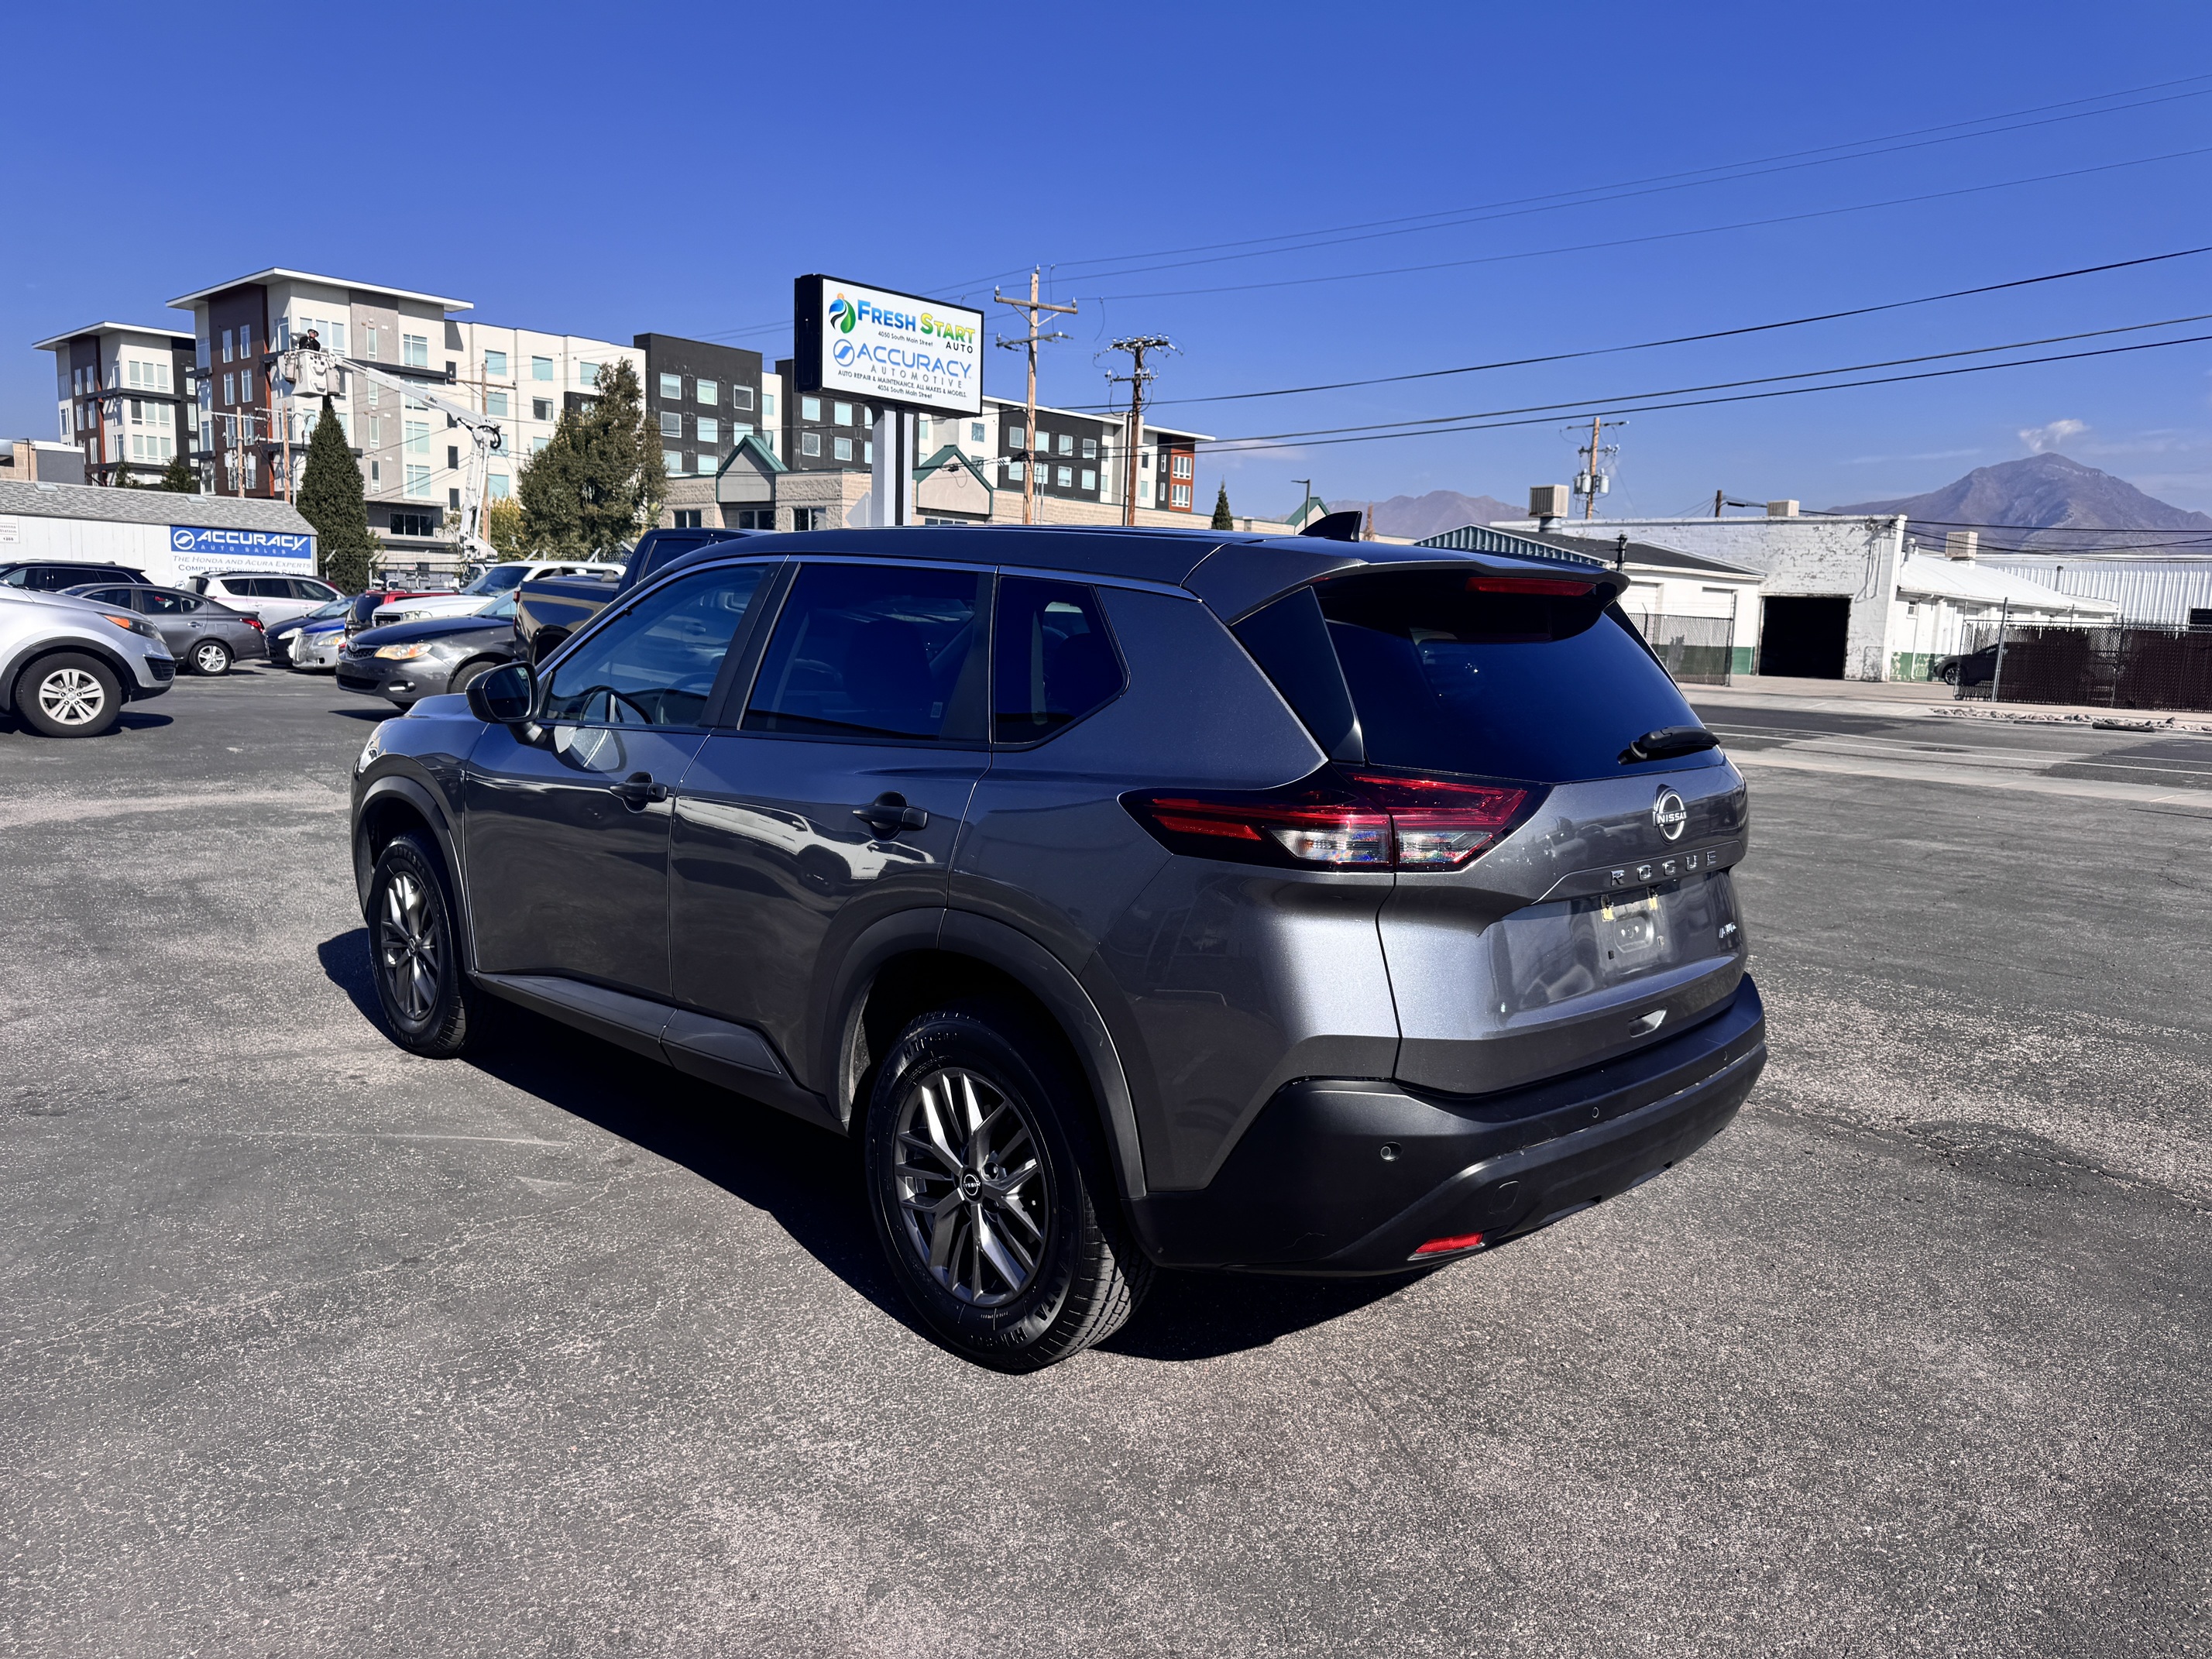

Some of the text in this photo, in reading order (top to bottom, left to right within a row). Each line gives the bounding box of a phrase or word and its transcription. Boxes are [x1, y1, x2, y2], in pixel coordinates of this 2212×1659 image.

[857, 299, 975, 344] FRESH START
[946, 341, 973, 354] AUTO
[857, 342, 972, 379] ACCURACY
[838, 369, 853, 378] AUTO
[854, 372, 871, 381] REPAIR
[871, 364, 962, 389] AUTOMOTIVE
[196, 531, 308, 551] ACCURACY
[245, 546, 287, 555] SALES
[192, 556, 223, 565] HONDA
[245, 558, 273, 567] ACURA
[1657, 811, 1687, 823] NISSAN
[1611, 850, 1716, 886] ROGUE
